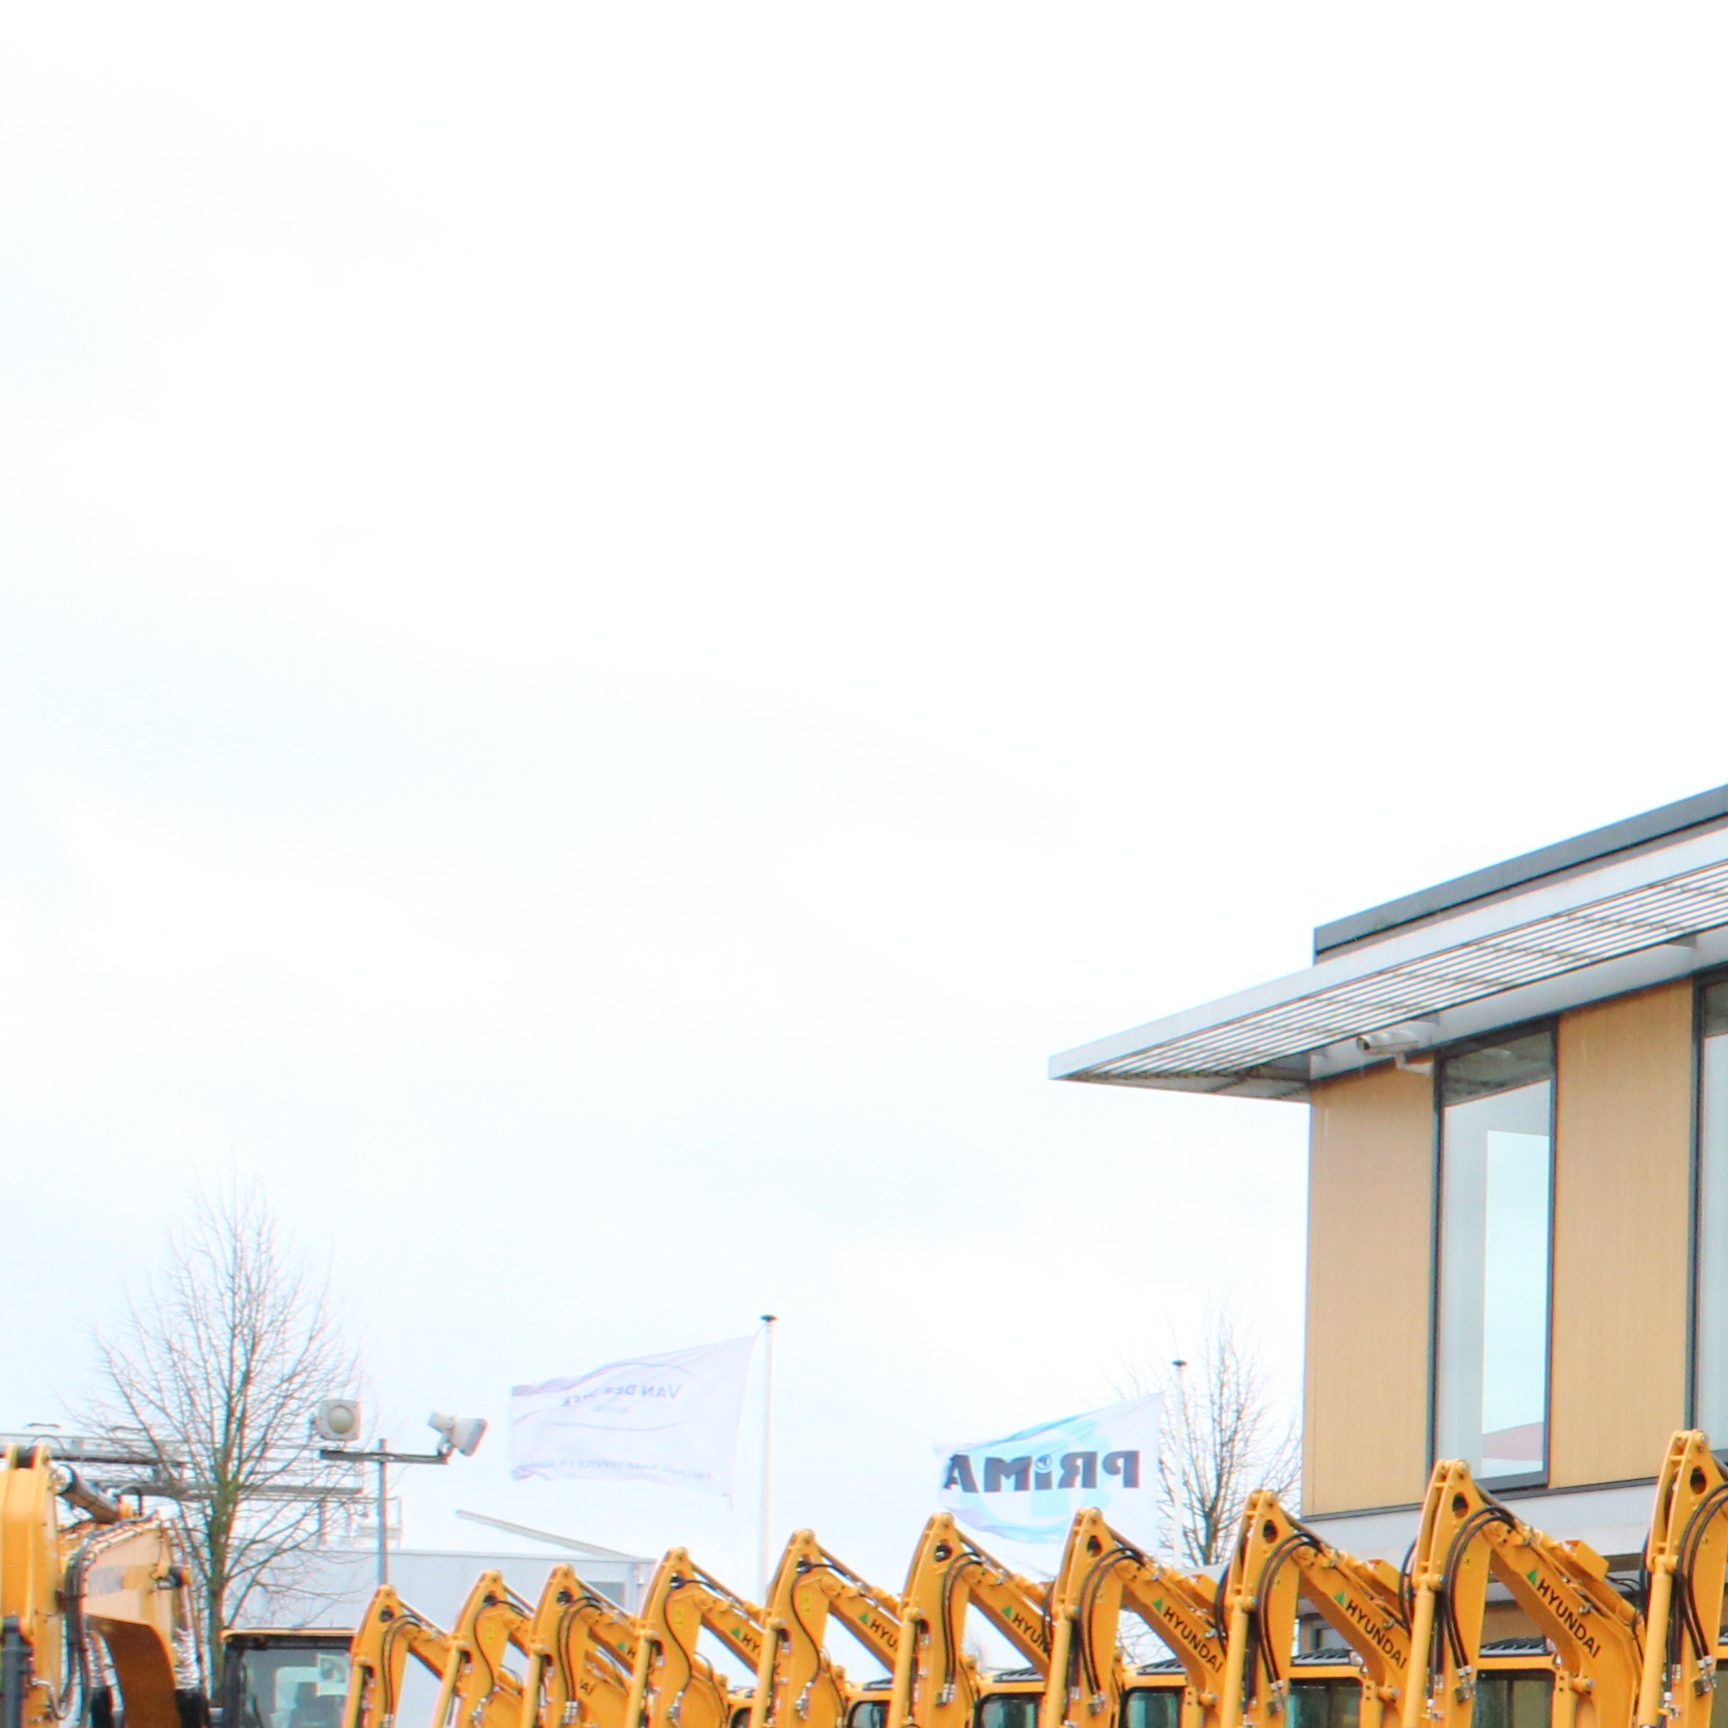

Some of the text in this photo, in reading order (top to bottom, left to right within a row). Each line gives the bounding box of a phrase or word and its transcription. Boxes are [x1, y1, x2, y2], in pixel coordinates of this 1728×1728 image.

[1163, 1606, 1224, 1673] HYUNDAI
[1345, 1598, 1407, 1670] HYUNDAI
[1536, 1579, 1601, 1658] HYUNDAI
